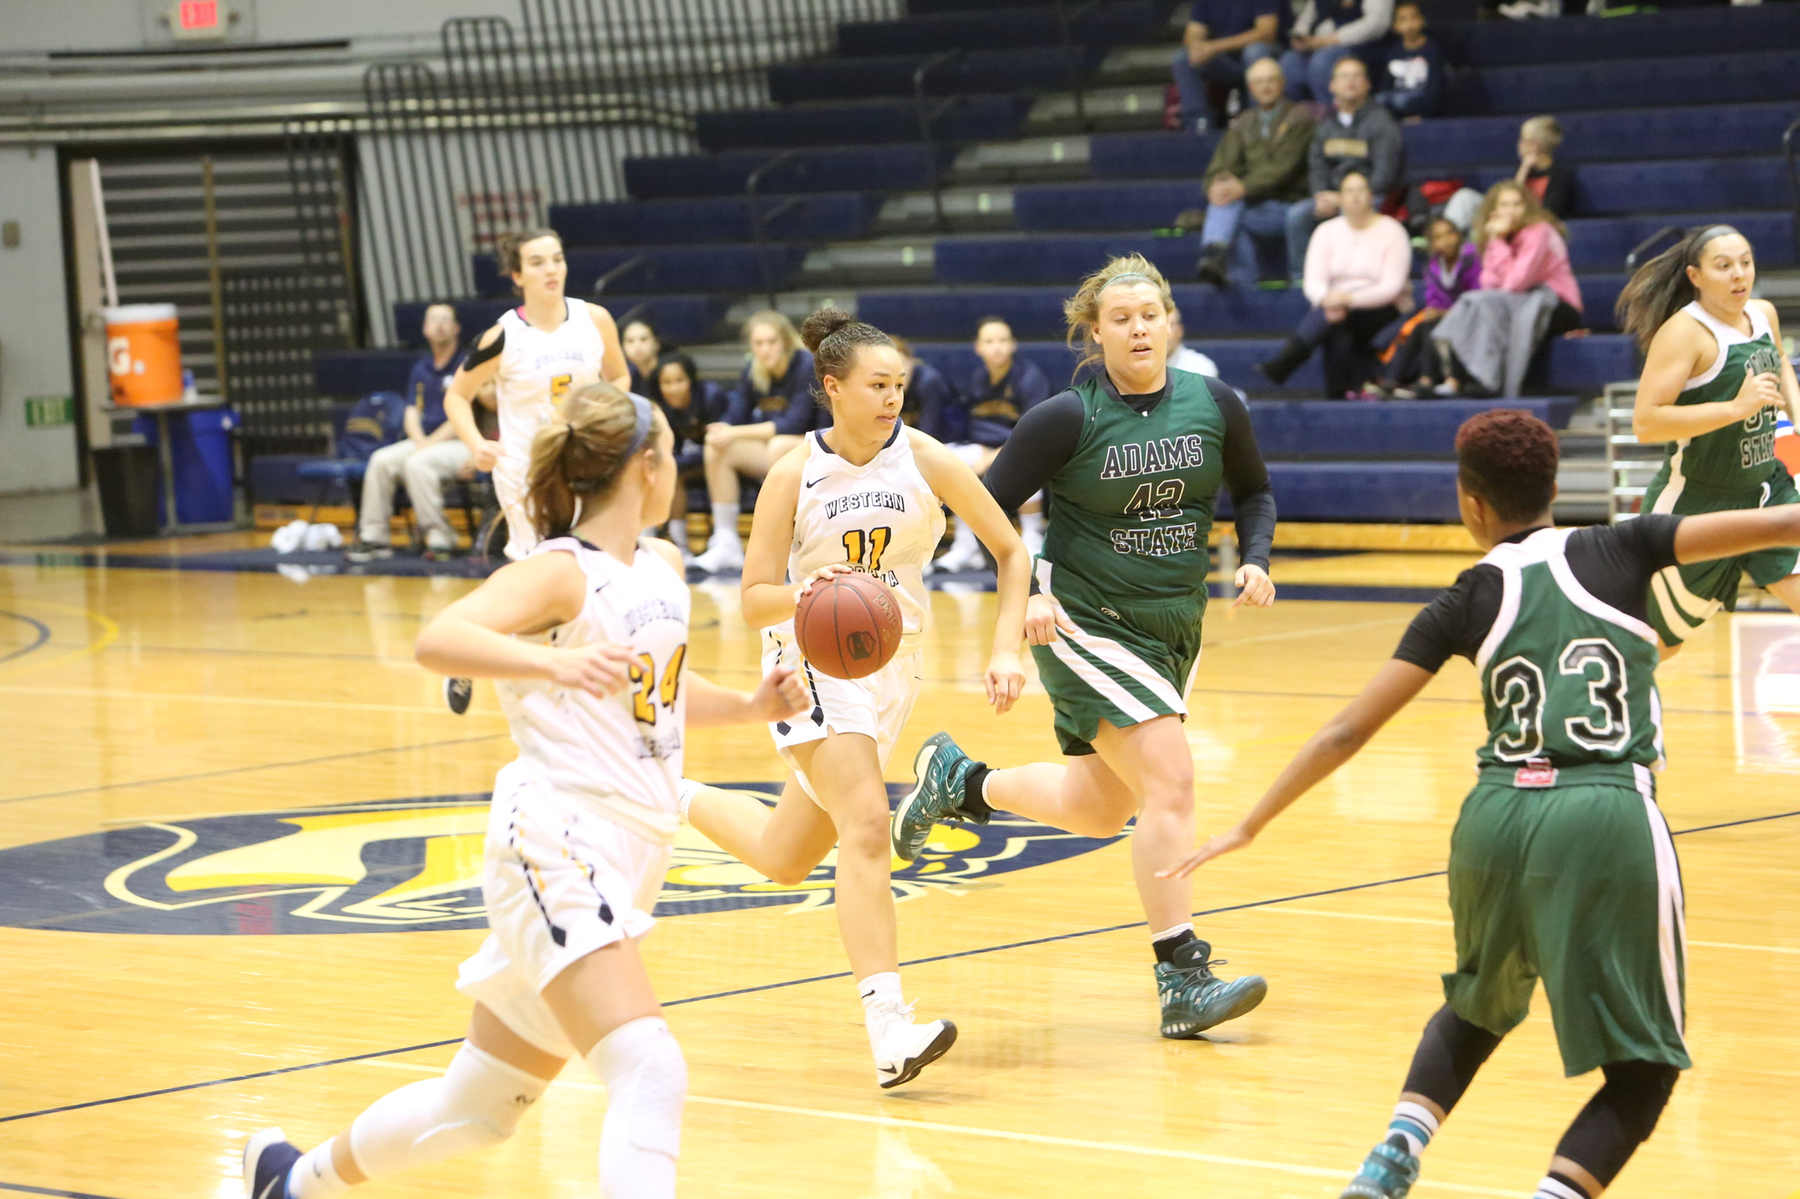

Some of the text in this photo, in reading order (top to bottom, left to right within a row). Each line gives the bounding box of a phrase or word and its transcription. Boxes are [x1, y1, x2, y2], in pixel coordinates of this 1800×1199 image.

[1101, 434, 1204, 479] ADAMS
[824, 491, 905, 520] WESTERN
[1123, 478, 1185, 522] 42
[842, 526, 891, 571] 11
[1110, 522, 1198, 556] STATE
[629, 643, 686, 726] 24
[1491, 638, 1631, 762] 33
